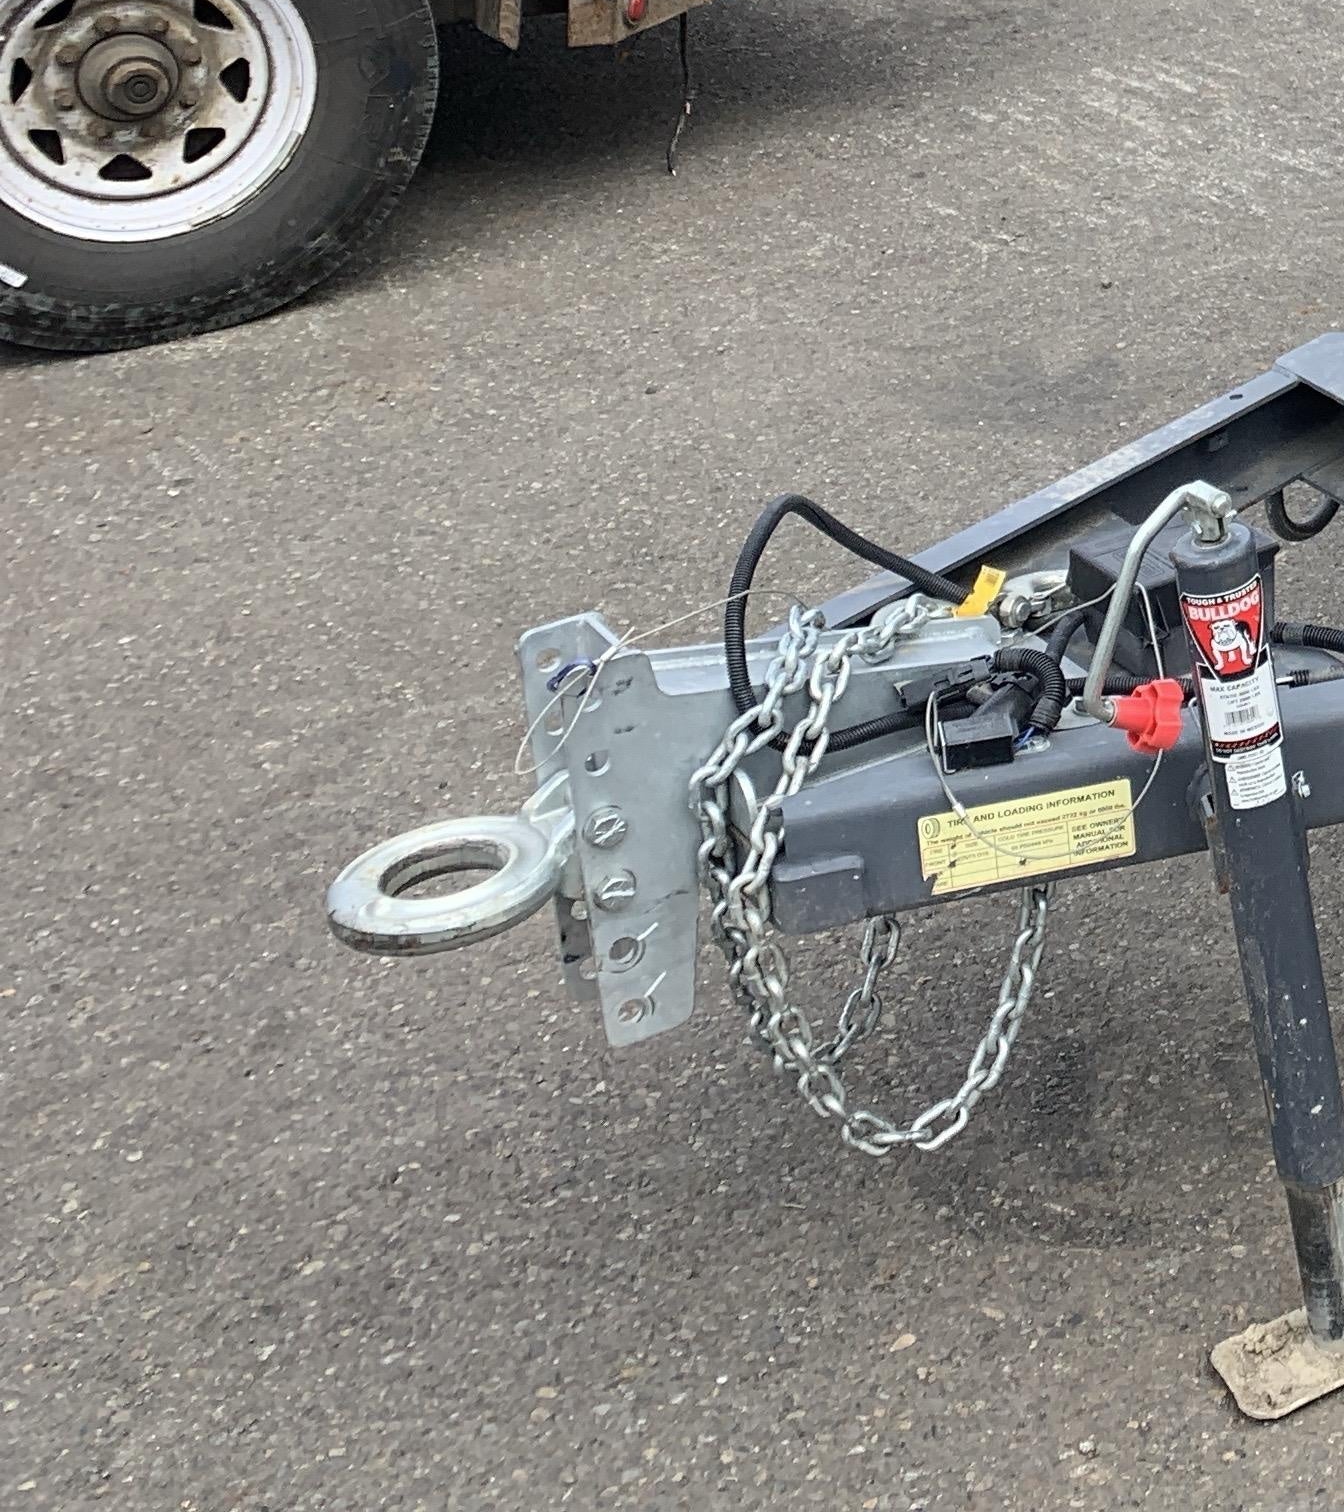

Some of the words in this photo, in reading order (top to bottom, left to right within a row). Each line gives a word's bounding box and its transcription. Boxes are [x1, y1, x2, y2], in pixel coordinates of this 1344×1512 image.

[1186, 596, 1215, 606] TOUGH
[1188, 589, 1260, 621] BULLDOG
[973, 811, 995, 823] AND
[998, 803, 1043, 819] LOADING
[1046, 789, 1115, 809] INFORMATION
